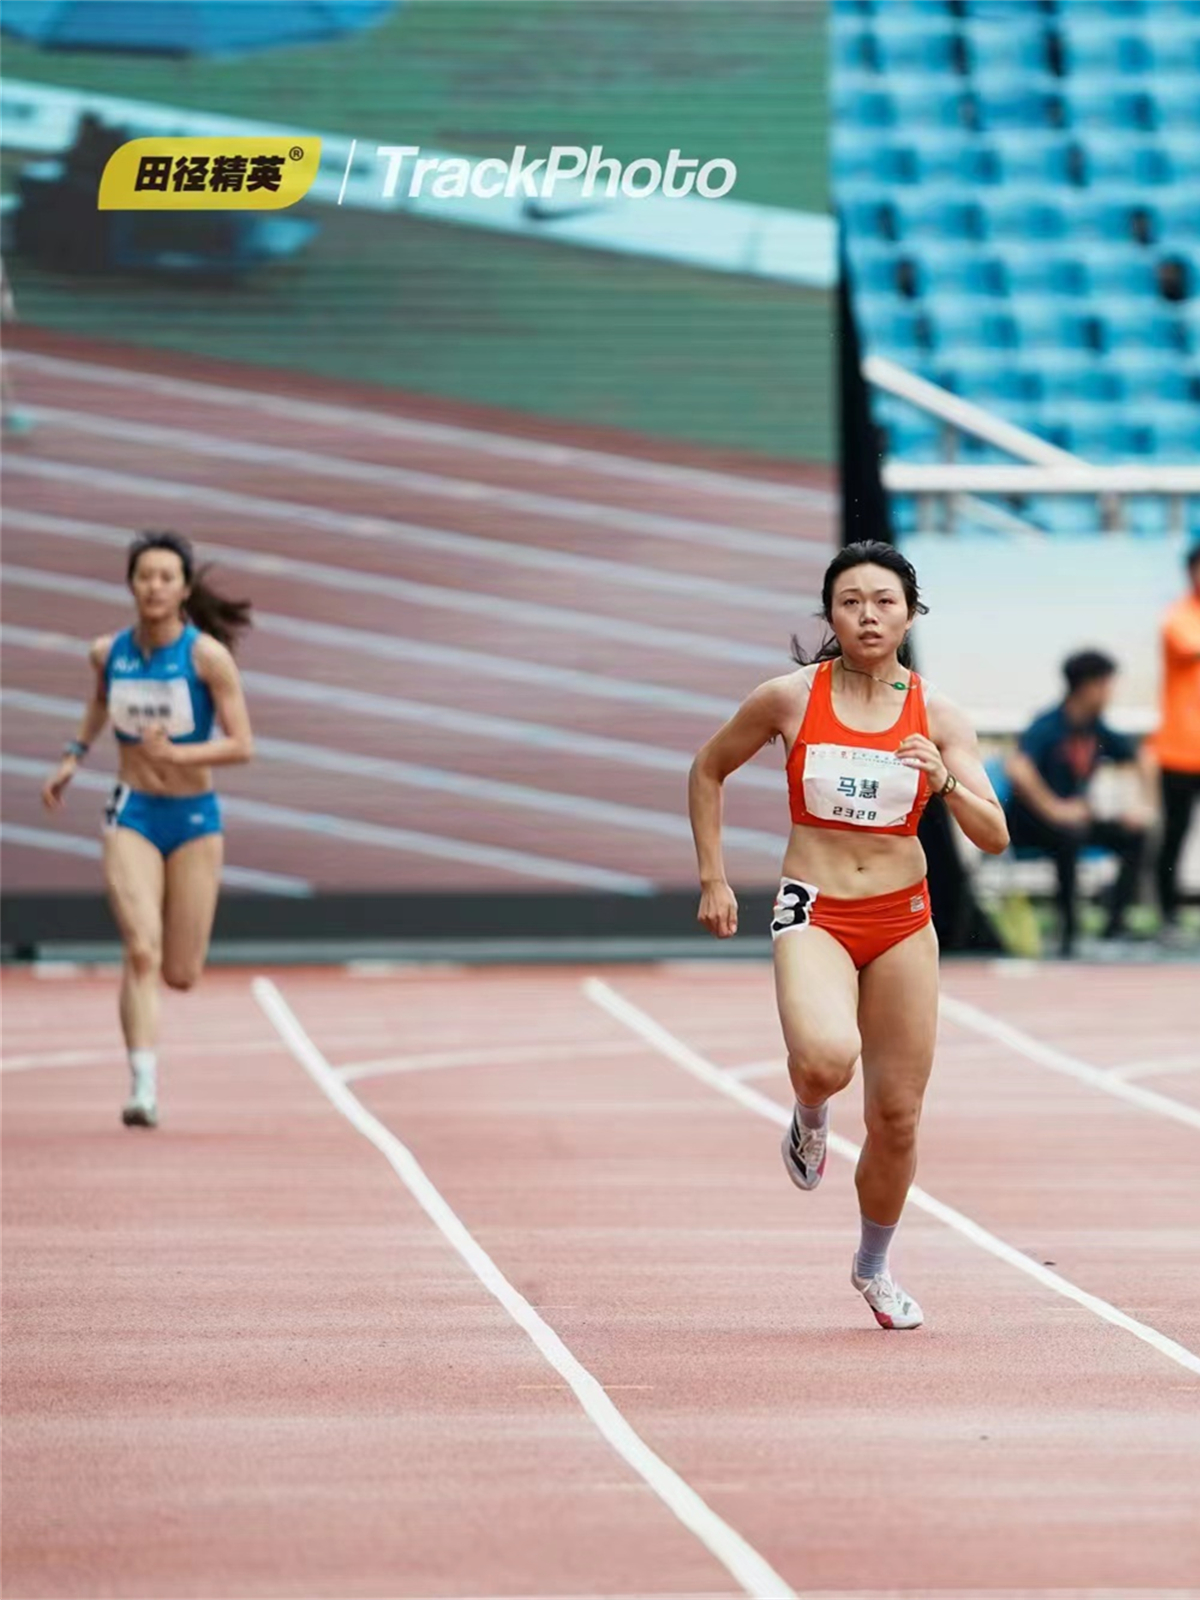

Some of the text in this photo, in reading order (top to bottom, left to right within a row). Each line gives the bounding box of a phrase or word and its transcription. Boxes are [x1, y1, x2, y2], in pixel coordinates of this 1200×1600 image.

[837, 776, 879, 799] 马慧
[832, 806, 877, 821] 2328
[774, 883, 810, 932] 3
